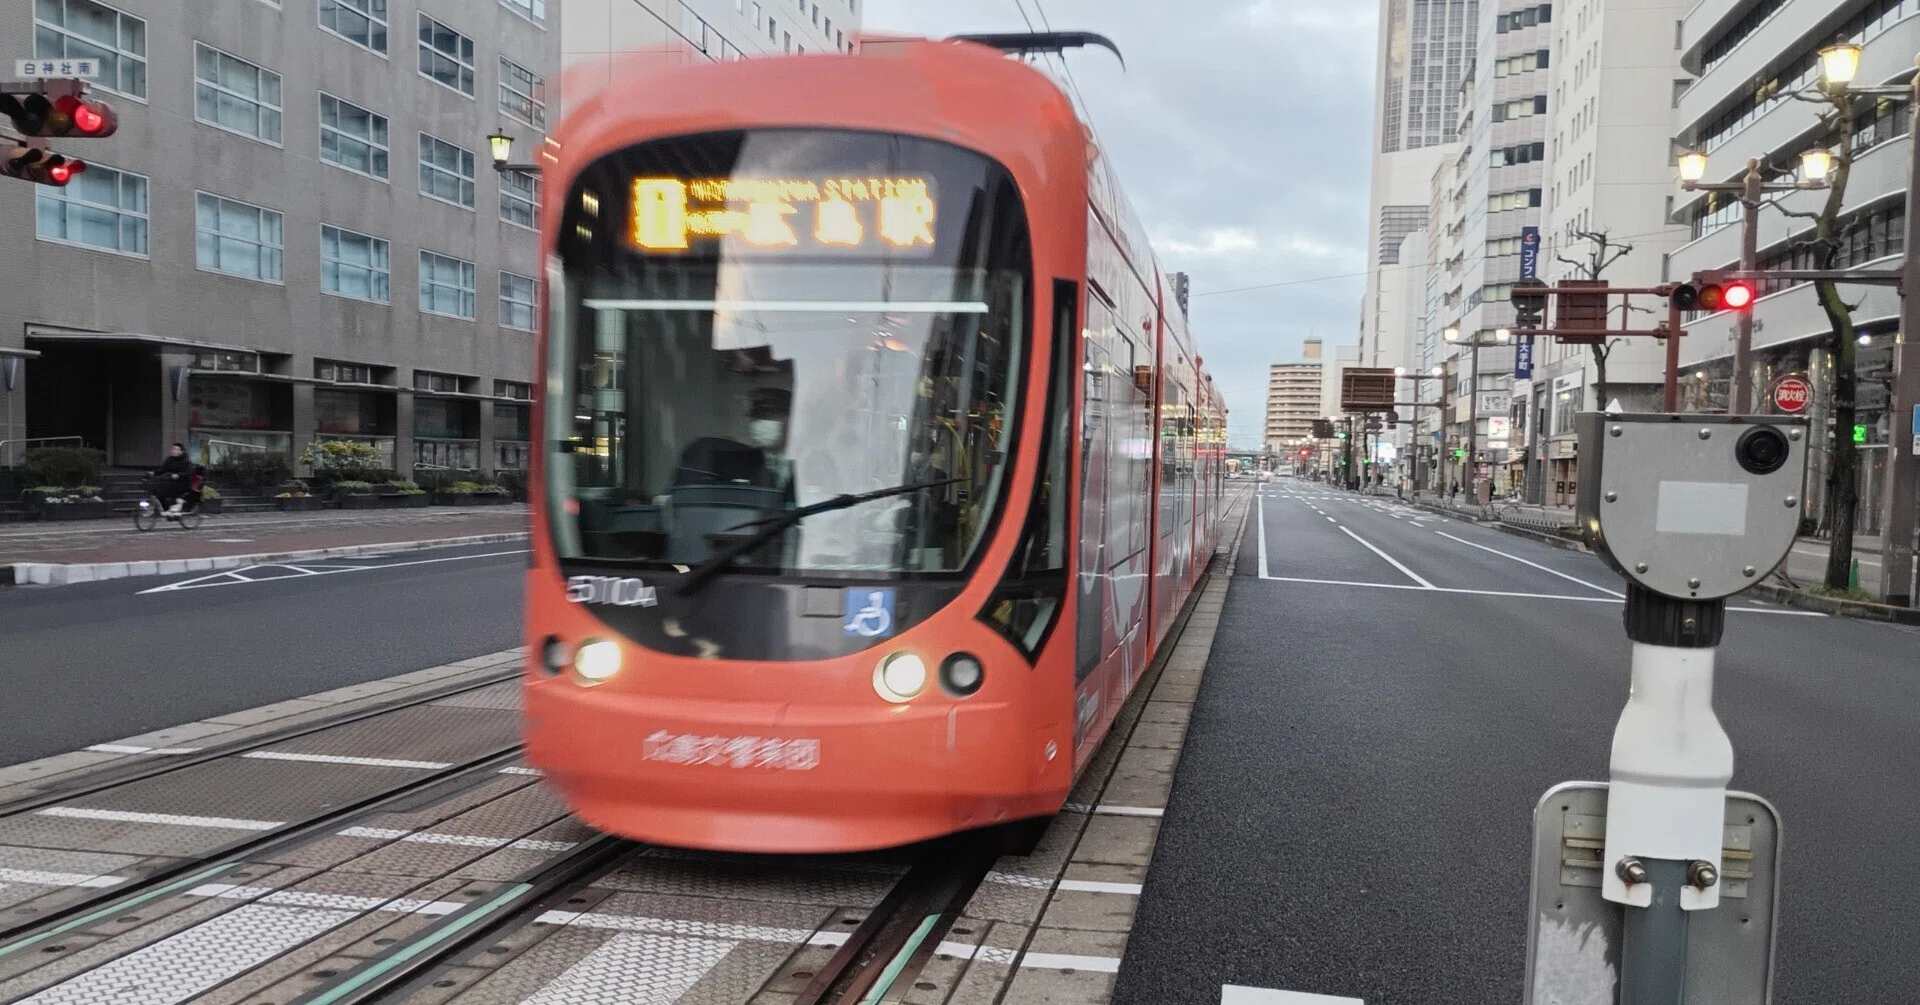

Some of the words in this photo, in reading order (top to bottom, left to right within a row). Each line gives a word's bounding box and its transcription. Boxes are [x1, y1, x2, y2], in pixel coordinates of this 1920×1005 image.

[24, 61, 91, 75] 白神社南
[1777, 389, 1805, 402] 消火栓
